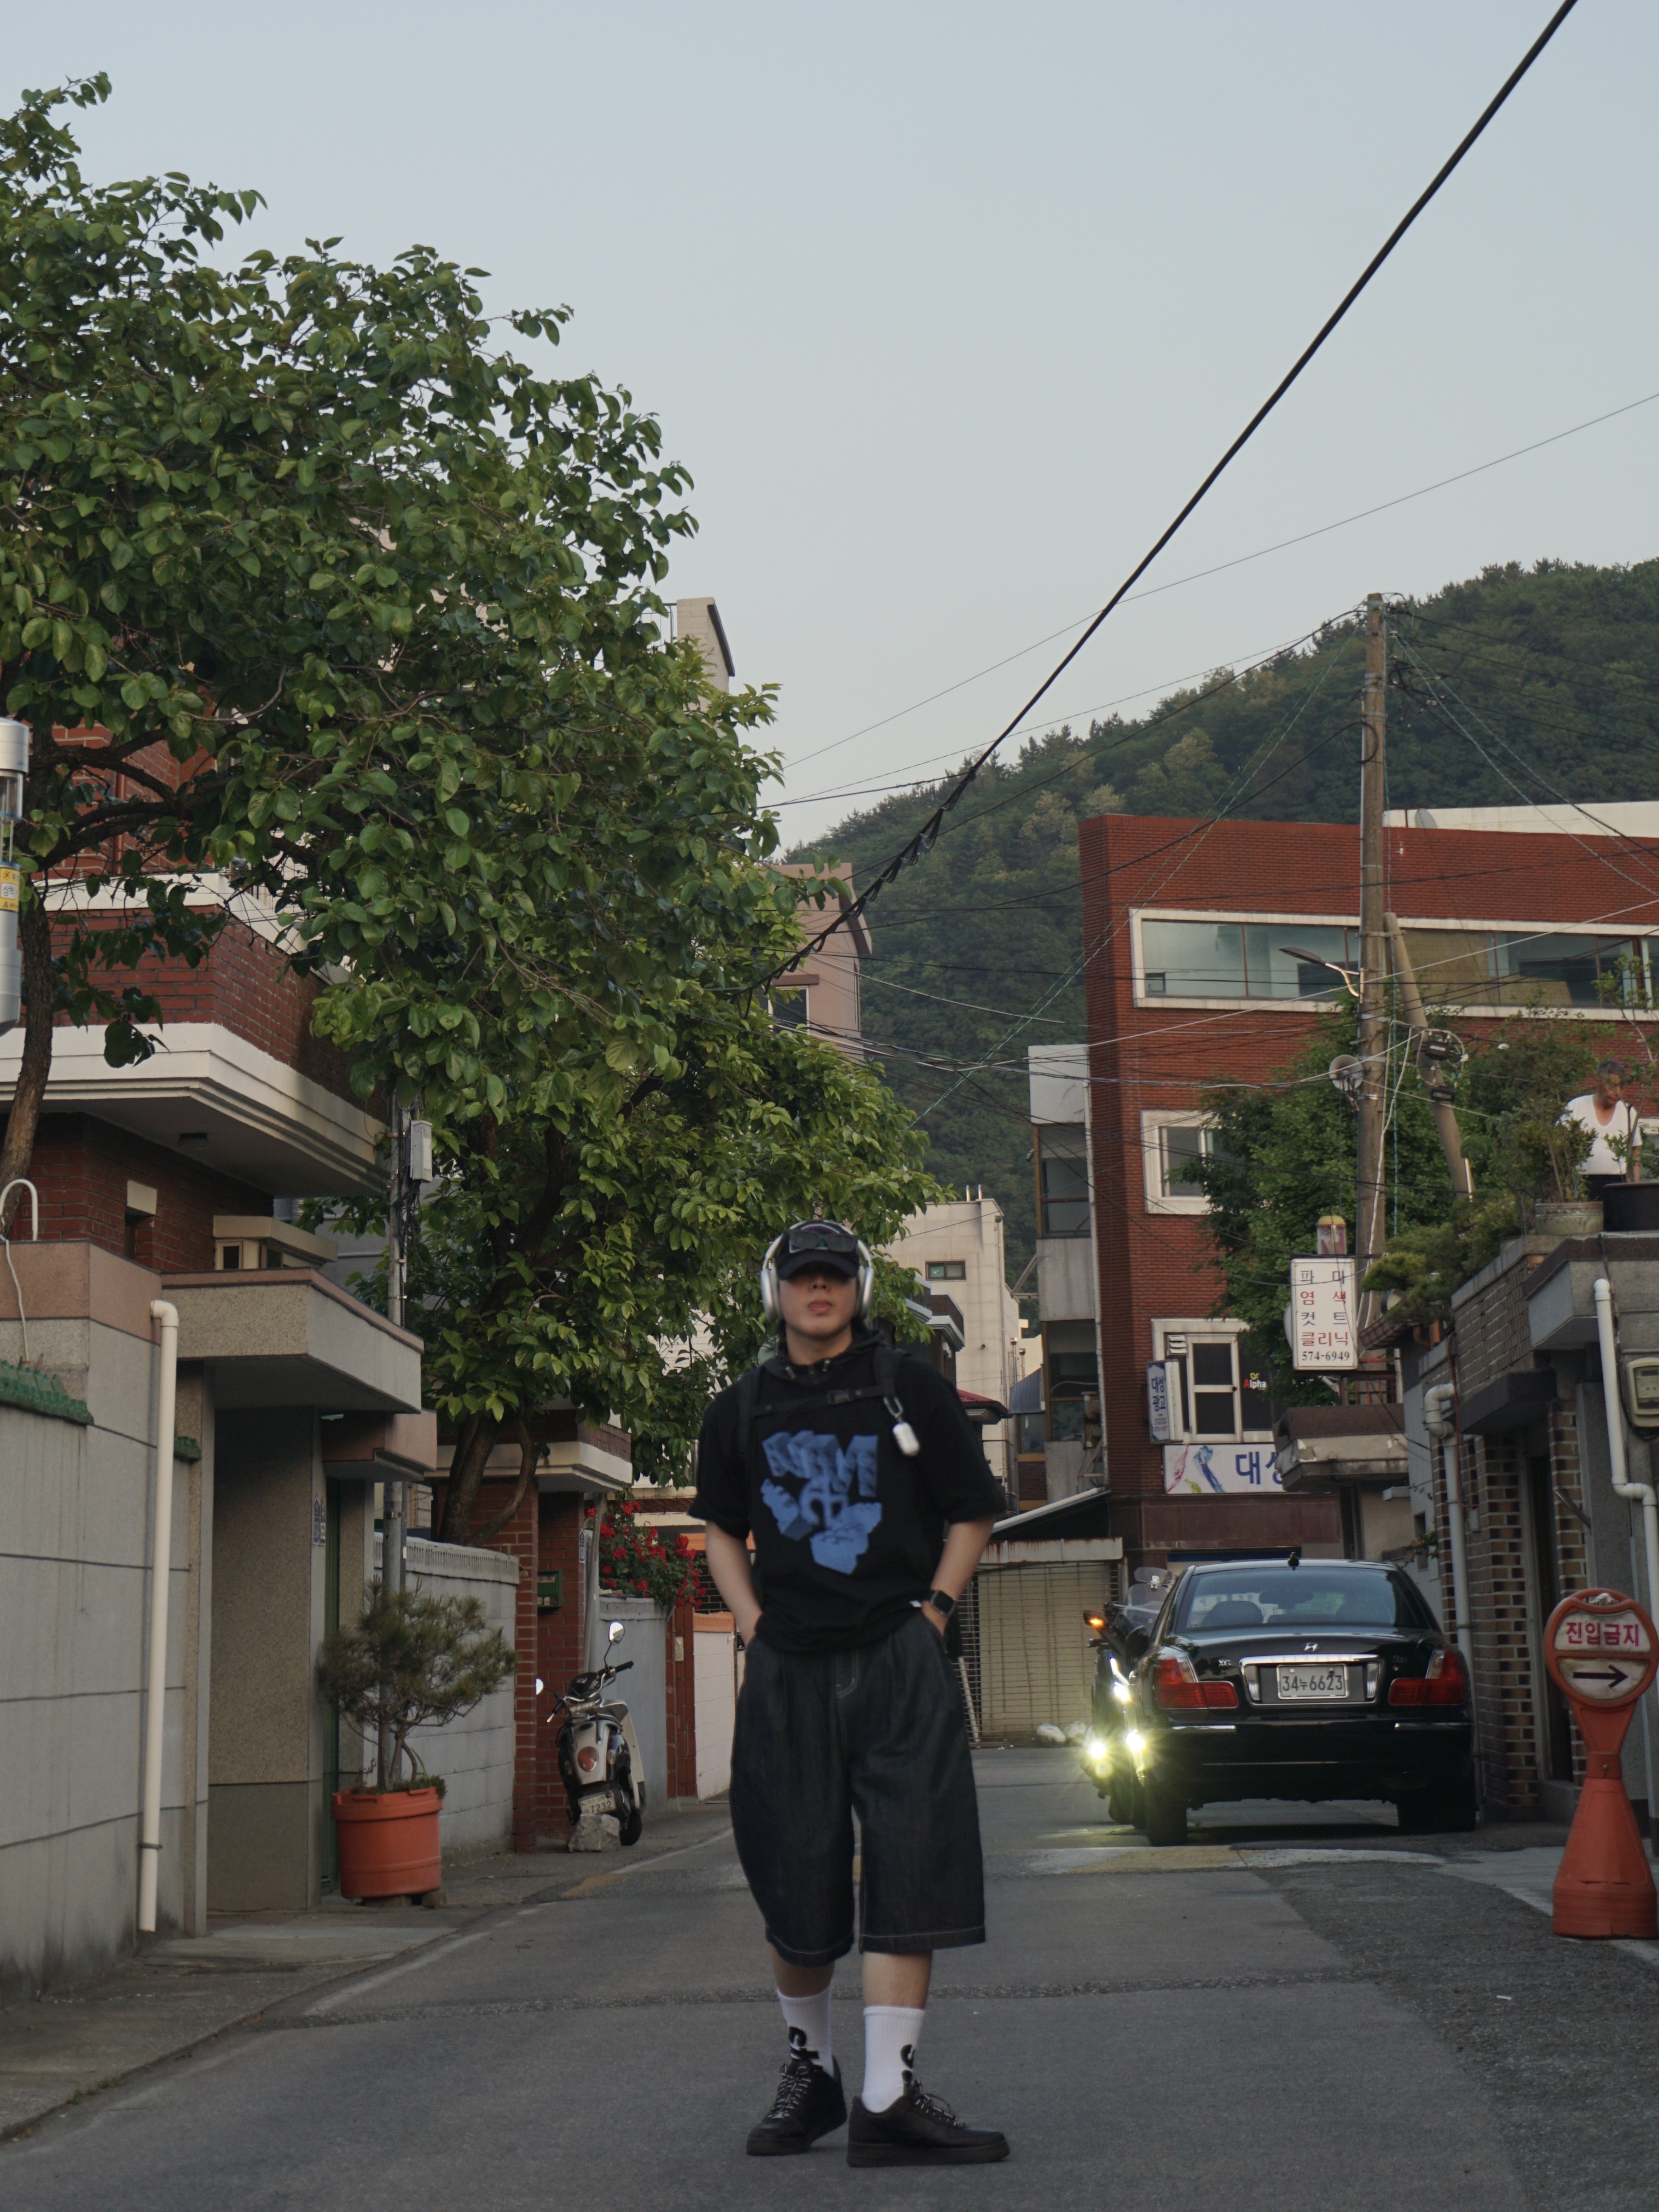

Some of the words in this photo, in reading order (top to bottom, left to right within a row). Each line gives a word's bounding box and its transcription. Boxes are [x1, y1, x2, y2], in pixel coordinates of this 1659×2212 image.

[1300, 1332, 1348, 1347] 클리닉
[1302, 1351, 1349, 1361] 574-6949
[1151, 1376, 1164, 1393] 대성
[1243, 1378, 1266, 1389] Alpha
[1152, 1395, 1166, 1412] 광고
[1566, 1622, 1639, 1647] 진입금지
[1282, 1675, 1343, 1691] 34누6623
